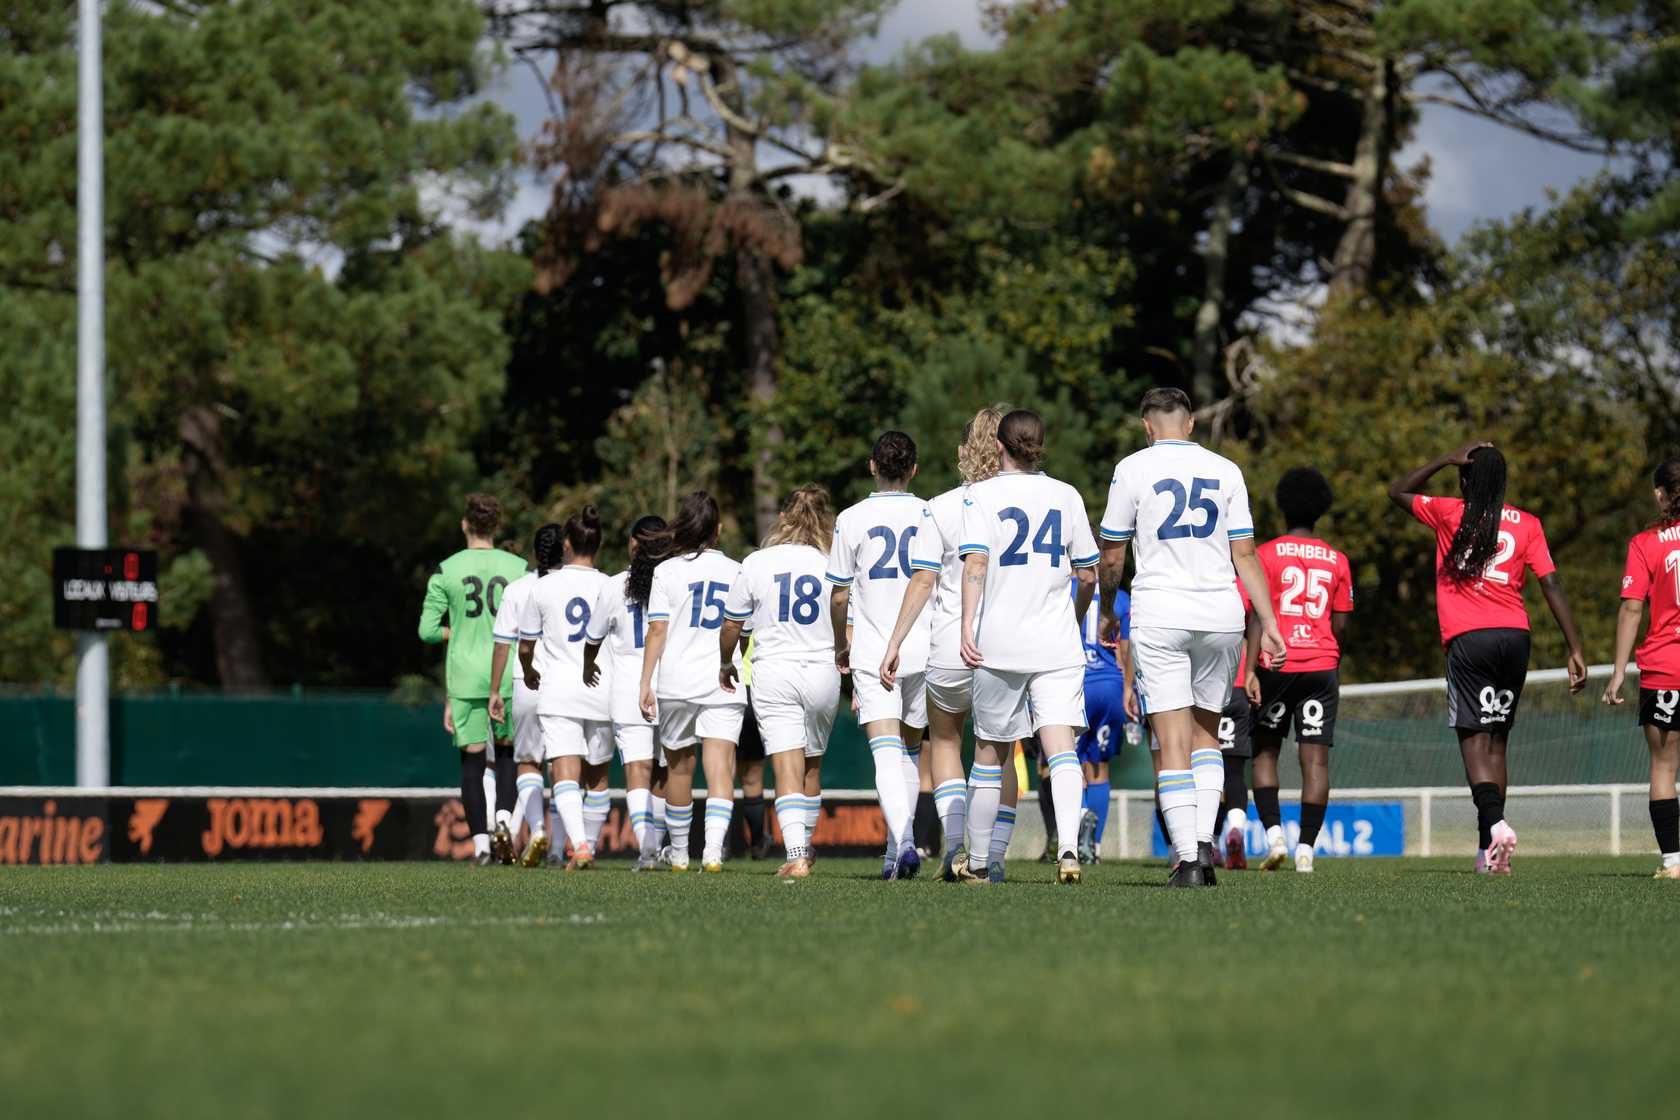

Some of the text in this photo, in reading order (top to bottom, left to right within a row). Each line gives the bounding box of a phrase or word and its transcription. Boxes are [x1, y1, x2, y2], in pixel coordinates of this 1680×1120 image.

[1152, 477, 1220, 539] 25
[997, 506, 1065, 568] 24
[1275, 542, 1338, 565] DEMBELE
[461, 575, 508, 618] 30
[688, 580, 730, 630] 15
[773, 571, 823, 625] 18
[1280, 566, 1333, 619] 25
[564, 596, 591, 643] 9
